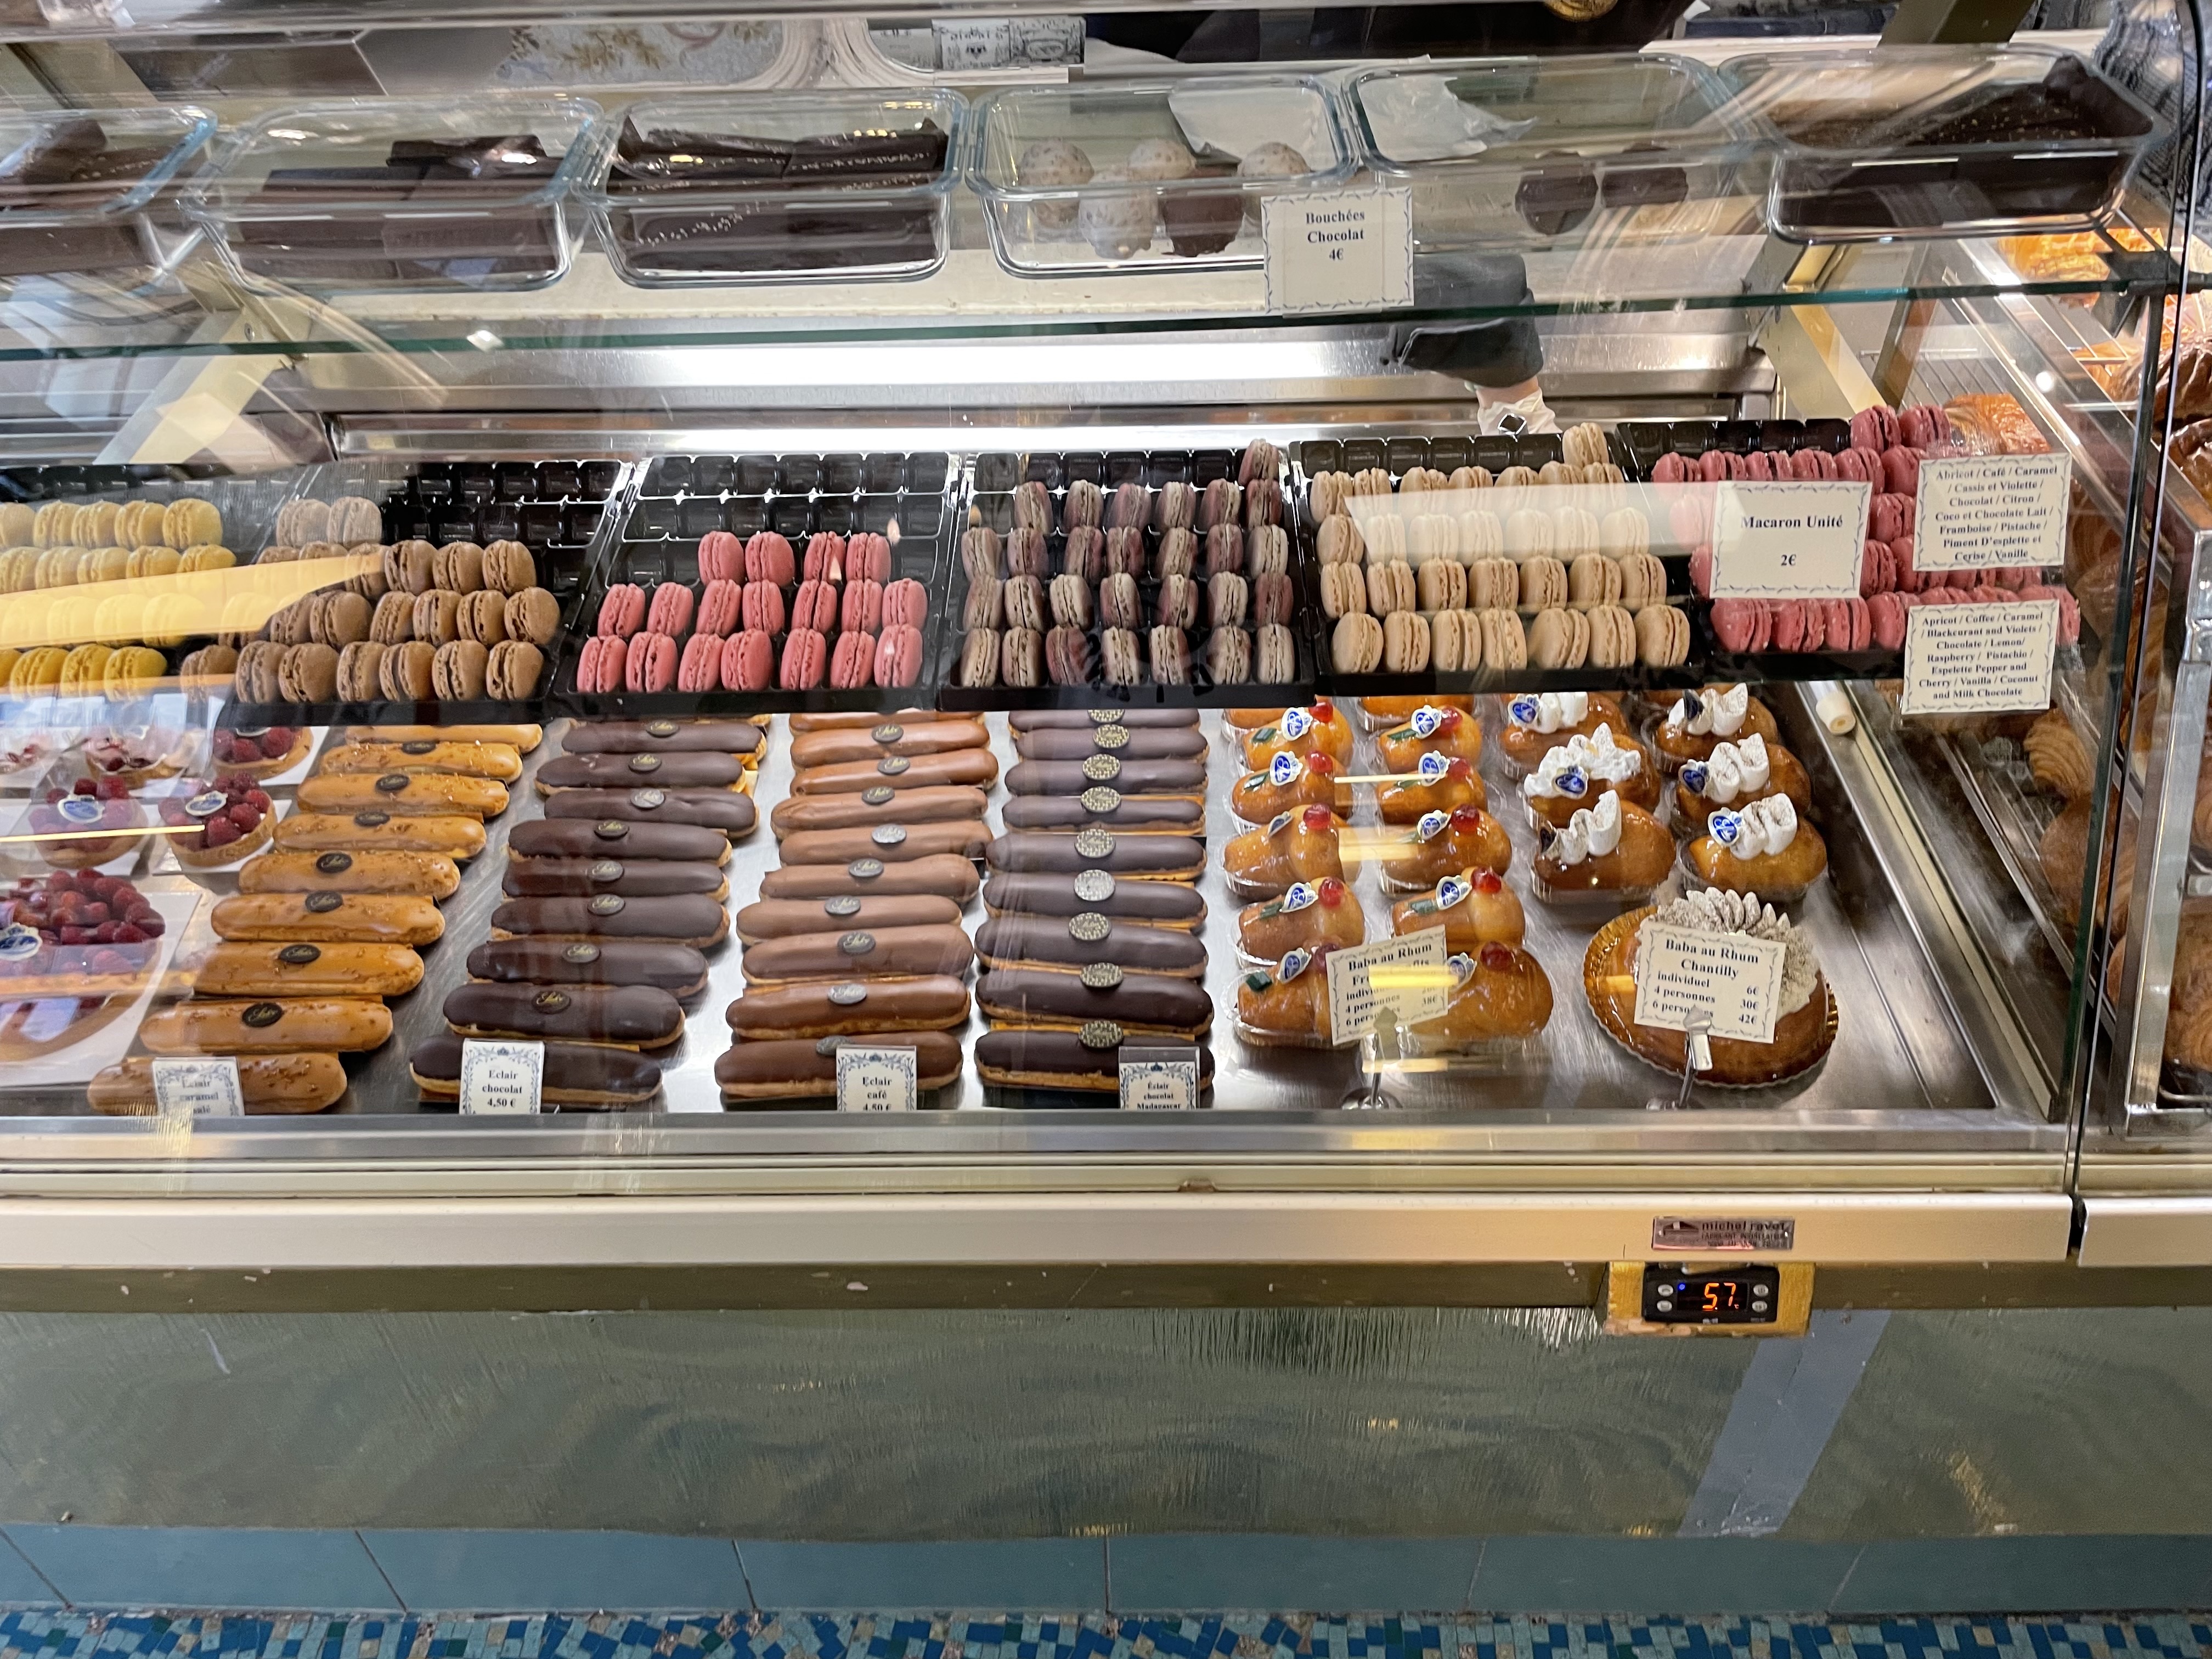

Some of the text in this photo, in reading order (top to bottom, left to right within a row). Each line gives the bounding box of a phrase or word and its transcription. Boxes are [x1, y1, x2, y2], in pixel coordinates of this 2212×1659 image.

[1306, 208, 1365, 224] Bouchées
[1307, 228, 1364, 244] Chocolat
[1329, 248, 1344, 261] 4€
[1936, 470, 1973, 480] Abricot
[1983, 468, 2006, 478] Café
[2015, 465, 2057, 476] Caramel
[1955, 482, 1984, 493] Cassis
[1988, 482, 1996, 490] et
[2000, 480, 2037, 490] Violette
[1950, 496, 1993, 507] Chocolat
[2002, 494, 2034, 504] Citron
[1936, 511, 1960, 521] Coco
[1963, 511, 1971, 520] et
[1975, 507, 2023, 518] Chocolate
[2027, 506, 2046, 517] Lait
[1741, 515, 1843, 529] Macaron Unité
[1940, 524, 1991, 535] Framboise
[2001, 521, 2041, 531] Pistache
[1943, 538, 1978, 548] Piment
[2033, 535, 2041, 544] et
[1781, 554, 1797, 567] 2€
[1955, 550, 1985, 561] Cerise
[1995, 549, 2028, 559] Vanille
[1922, 616, 1956, 627] Apricot
[1966, 614, 1994, 624] Coffee
[2004, 612, 2043, 621] Caramel
[1985, 626, 2002, 635] and
[2006, 625, 2036, 634] Violets
[1937, 639, 1981, 650] Chocolate
[1927, 653, 1975, 664] Raspberry
[1987, 651, 2027, 660] Pistachio
[1932, 662, 2027, 676] Espelette Pepper and
[1919, 679, 1951, 689] Cherry
[1961, 676, 1991, 686] Vanilla
[2000, 674, 2038, 684] Coconut
[1933, 687, 2022, 699] and Milk Chocolate
[1348, 944, 1432, 972] Baba au Rhum
[1666, 939, 1759, 964] Baba au Rhum
[1681, 958, 1739, 980] Chantilly
[1658, 970, 1759, 996] individuel 6€
[1345, 994, 1400, 1014] 4 personnes
[1654, 985, 1759, 1011] 4 personnes 30€
[1652, 1000, 1758, 1025] 6 persoes 42€
[1346, 1018, 1351, 1026] 6
[489, 1069, 518, 1080] Eclair
[862, 1076, 892, 1087] Eclair
[482, 1084, 522, 1094] chocolat
[867, 1089, 887, 1099] café
[510, 1098, 516, 1107] €
